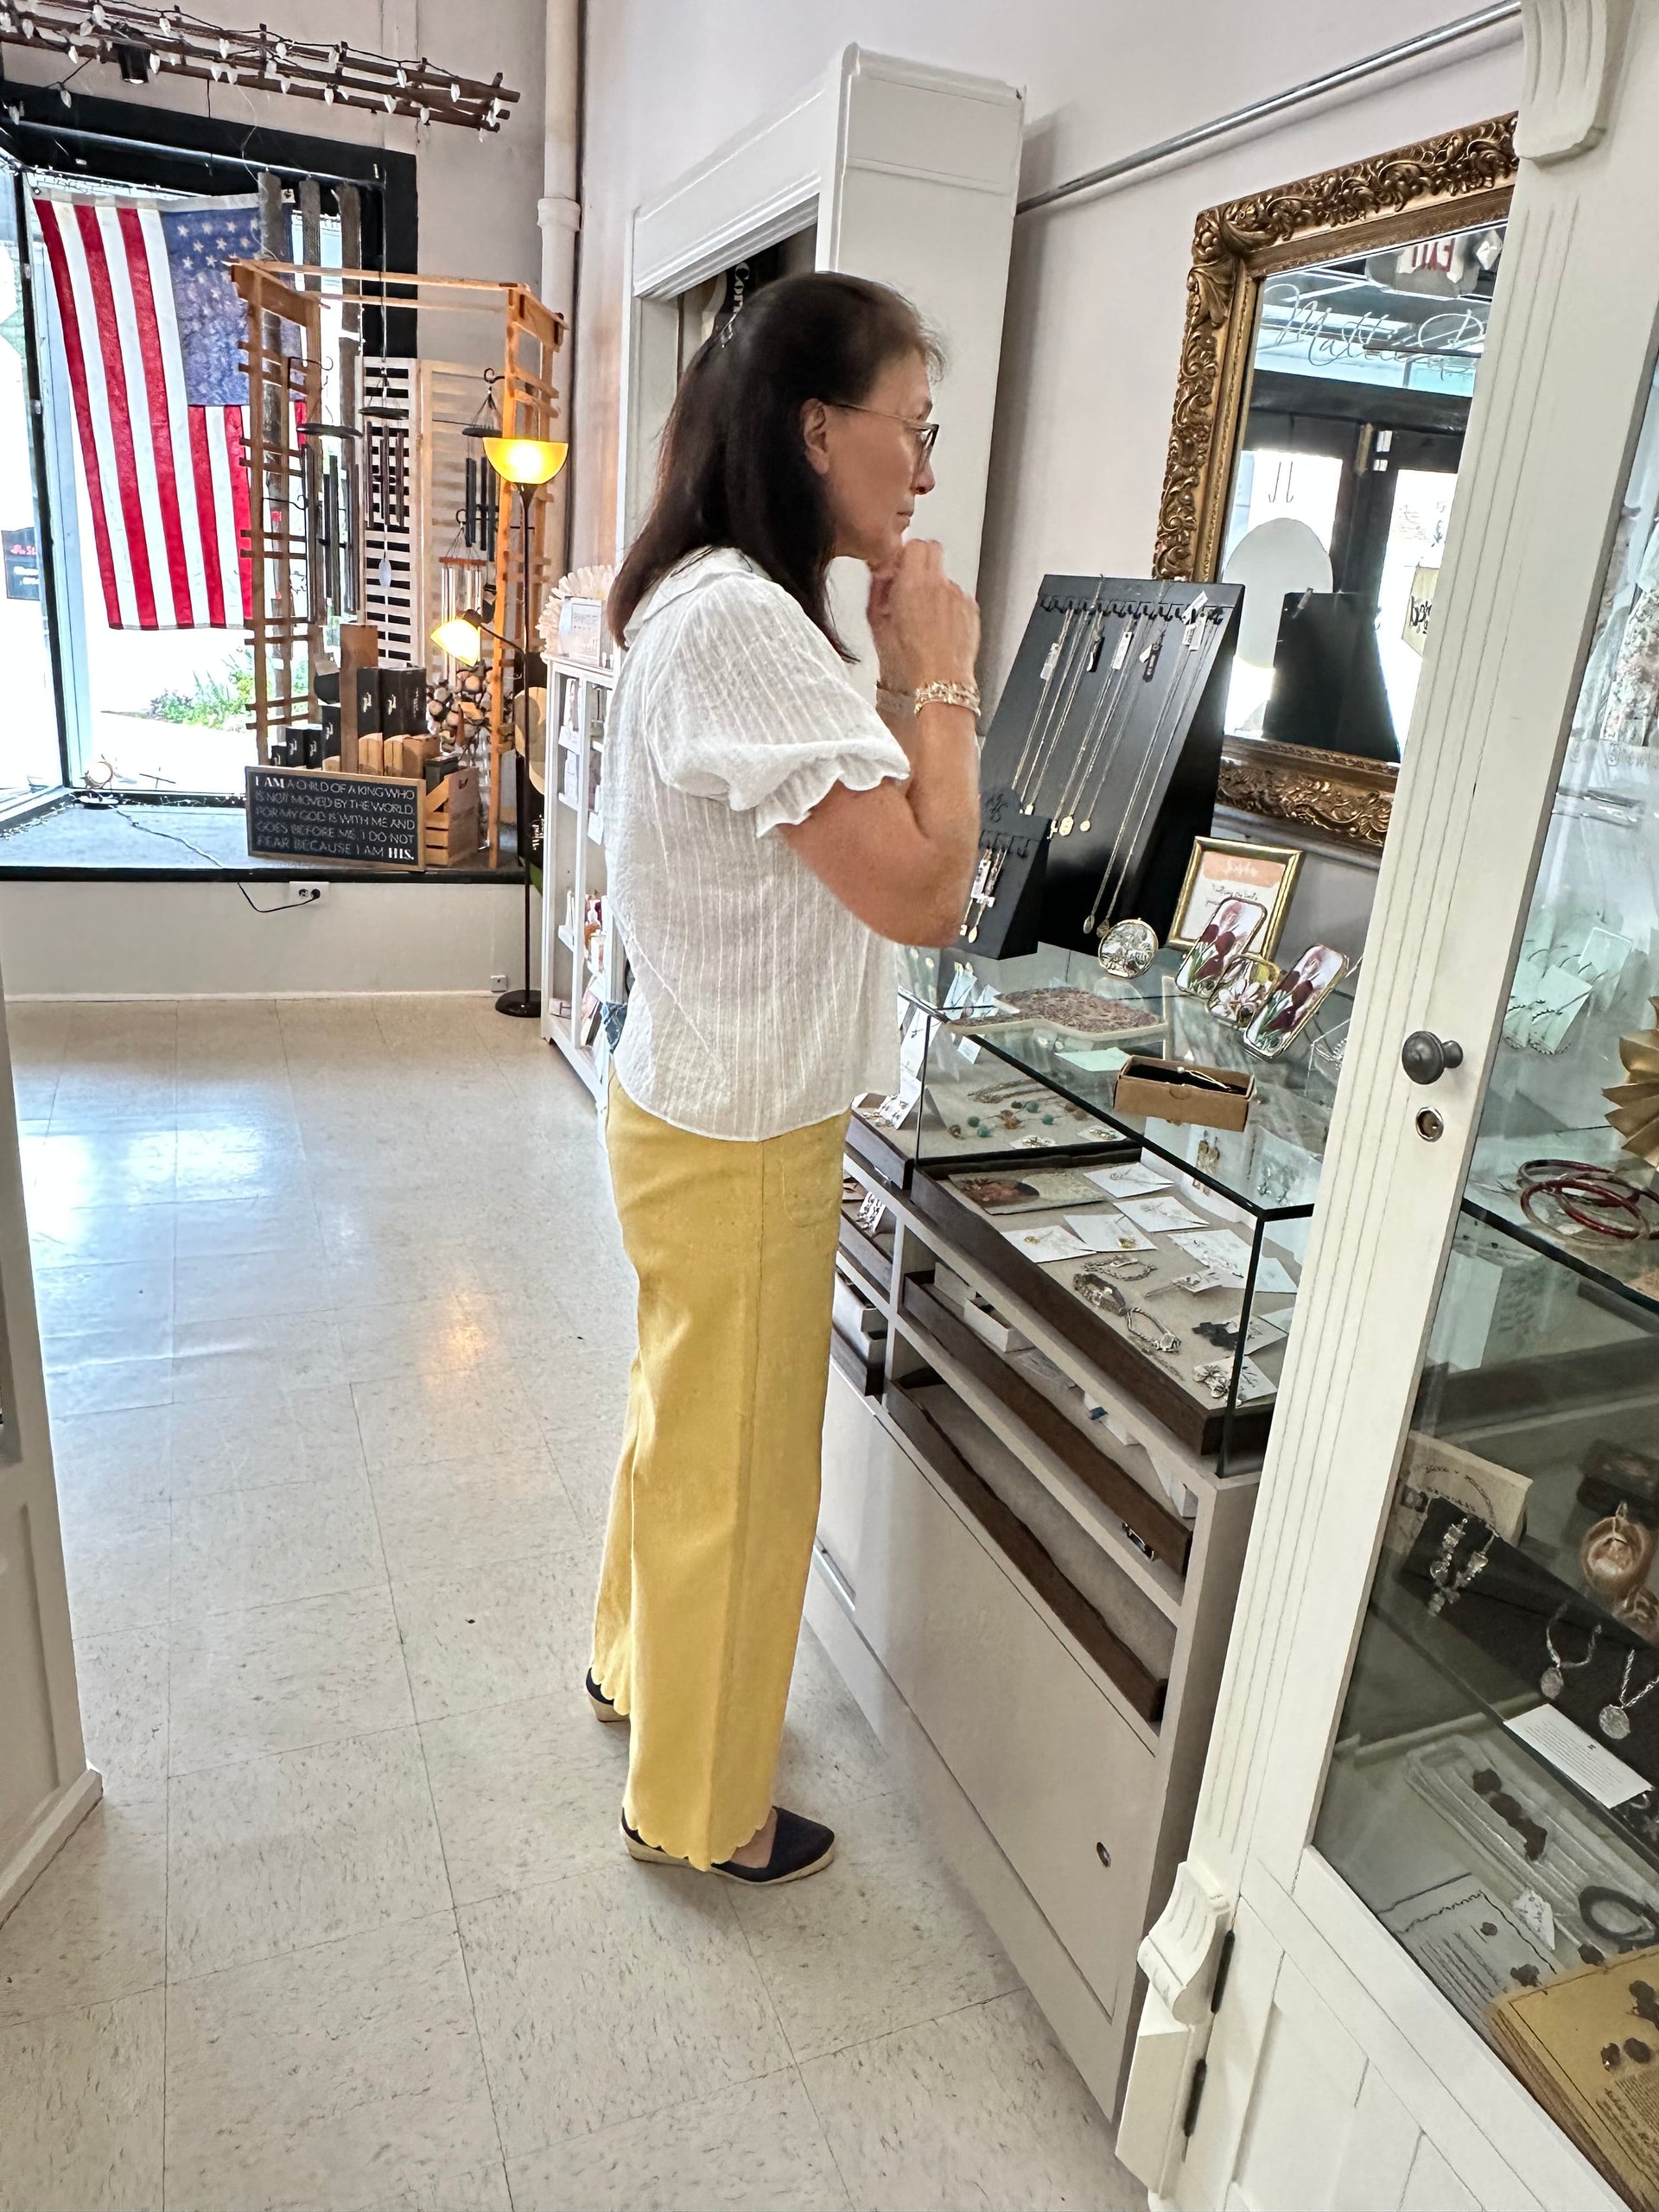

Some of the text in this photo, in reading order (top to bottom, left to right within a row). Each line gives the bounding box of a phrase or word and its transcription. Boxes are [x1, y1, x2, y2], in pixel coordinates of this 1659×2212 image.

[255, 775, 259, 786] I
[264, 777, 284, 789] AM
[287, 779, 295, 790] A
[330, 782, 346, 793] OF
[347, 785, 356, 794] A
[358, 785, 384, 798] KING
[385, 787, 415, 800] WHO
[266, 791, 289, 804] NOT
[291, 793, 333, 808] MOVED
[334, 798, 347, 809] BY
[349, 799, 371, 811] THE
[278, 808, 298, 819] MY
[299, 810, 326, 822] GOD
[328, 812, 338, 823] IS
[339, 812, 369, 825] WITH
[372, 817, 388, 828] ME
[390, 818, 415, 830] AND
[256, 836, 290, 849] FEAR
[294, 838, 352, 855] BECAUSE
[364, 845, 384, 857] AM
[369, 830, 387, 842] DO
[390, 833, 415, 844] NOT
